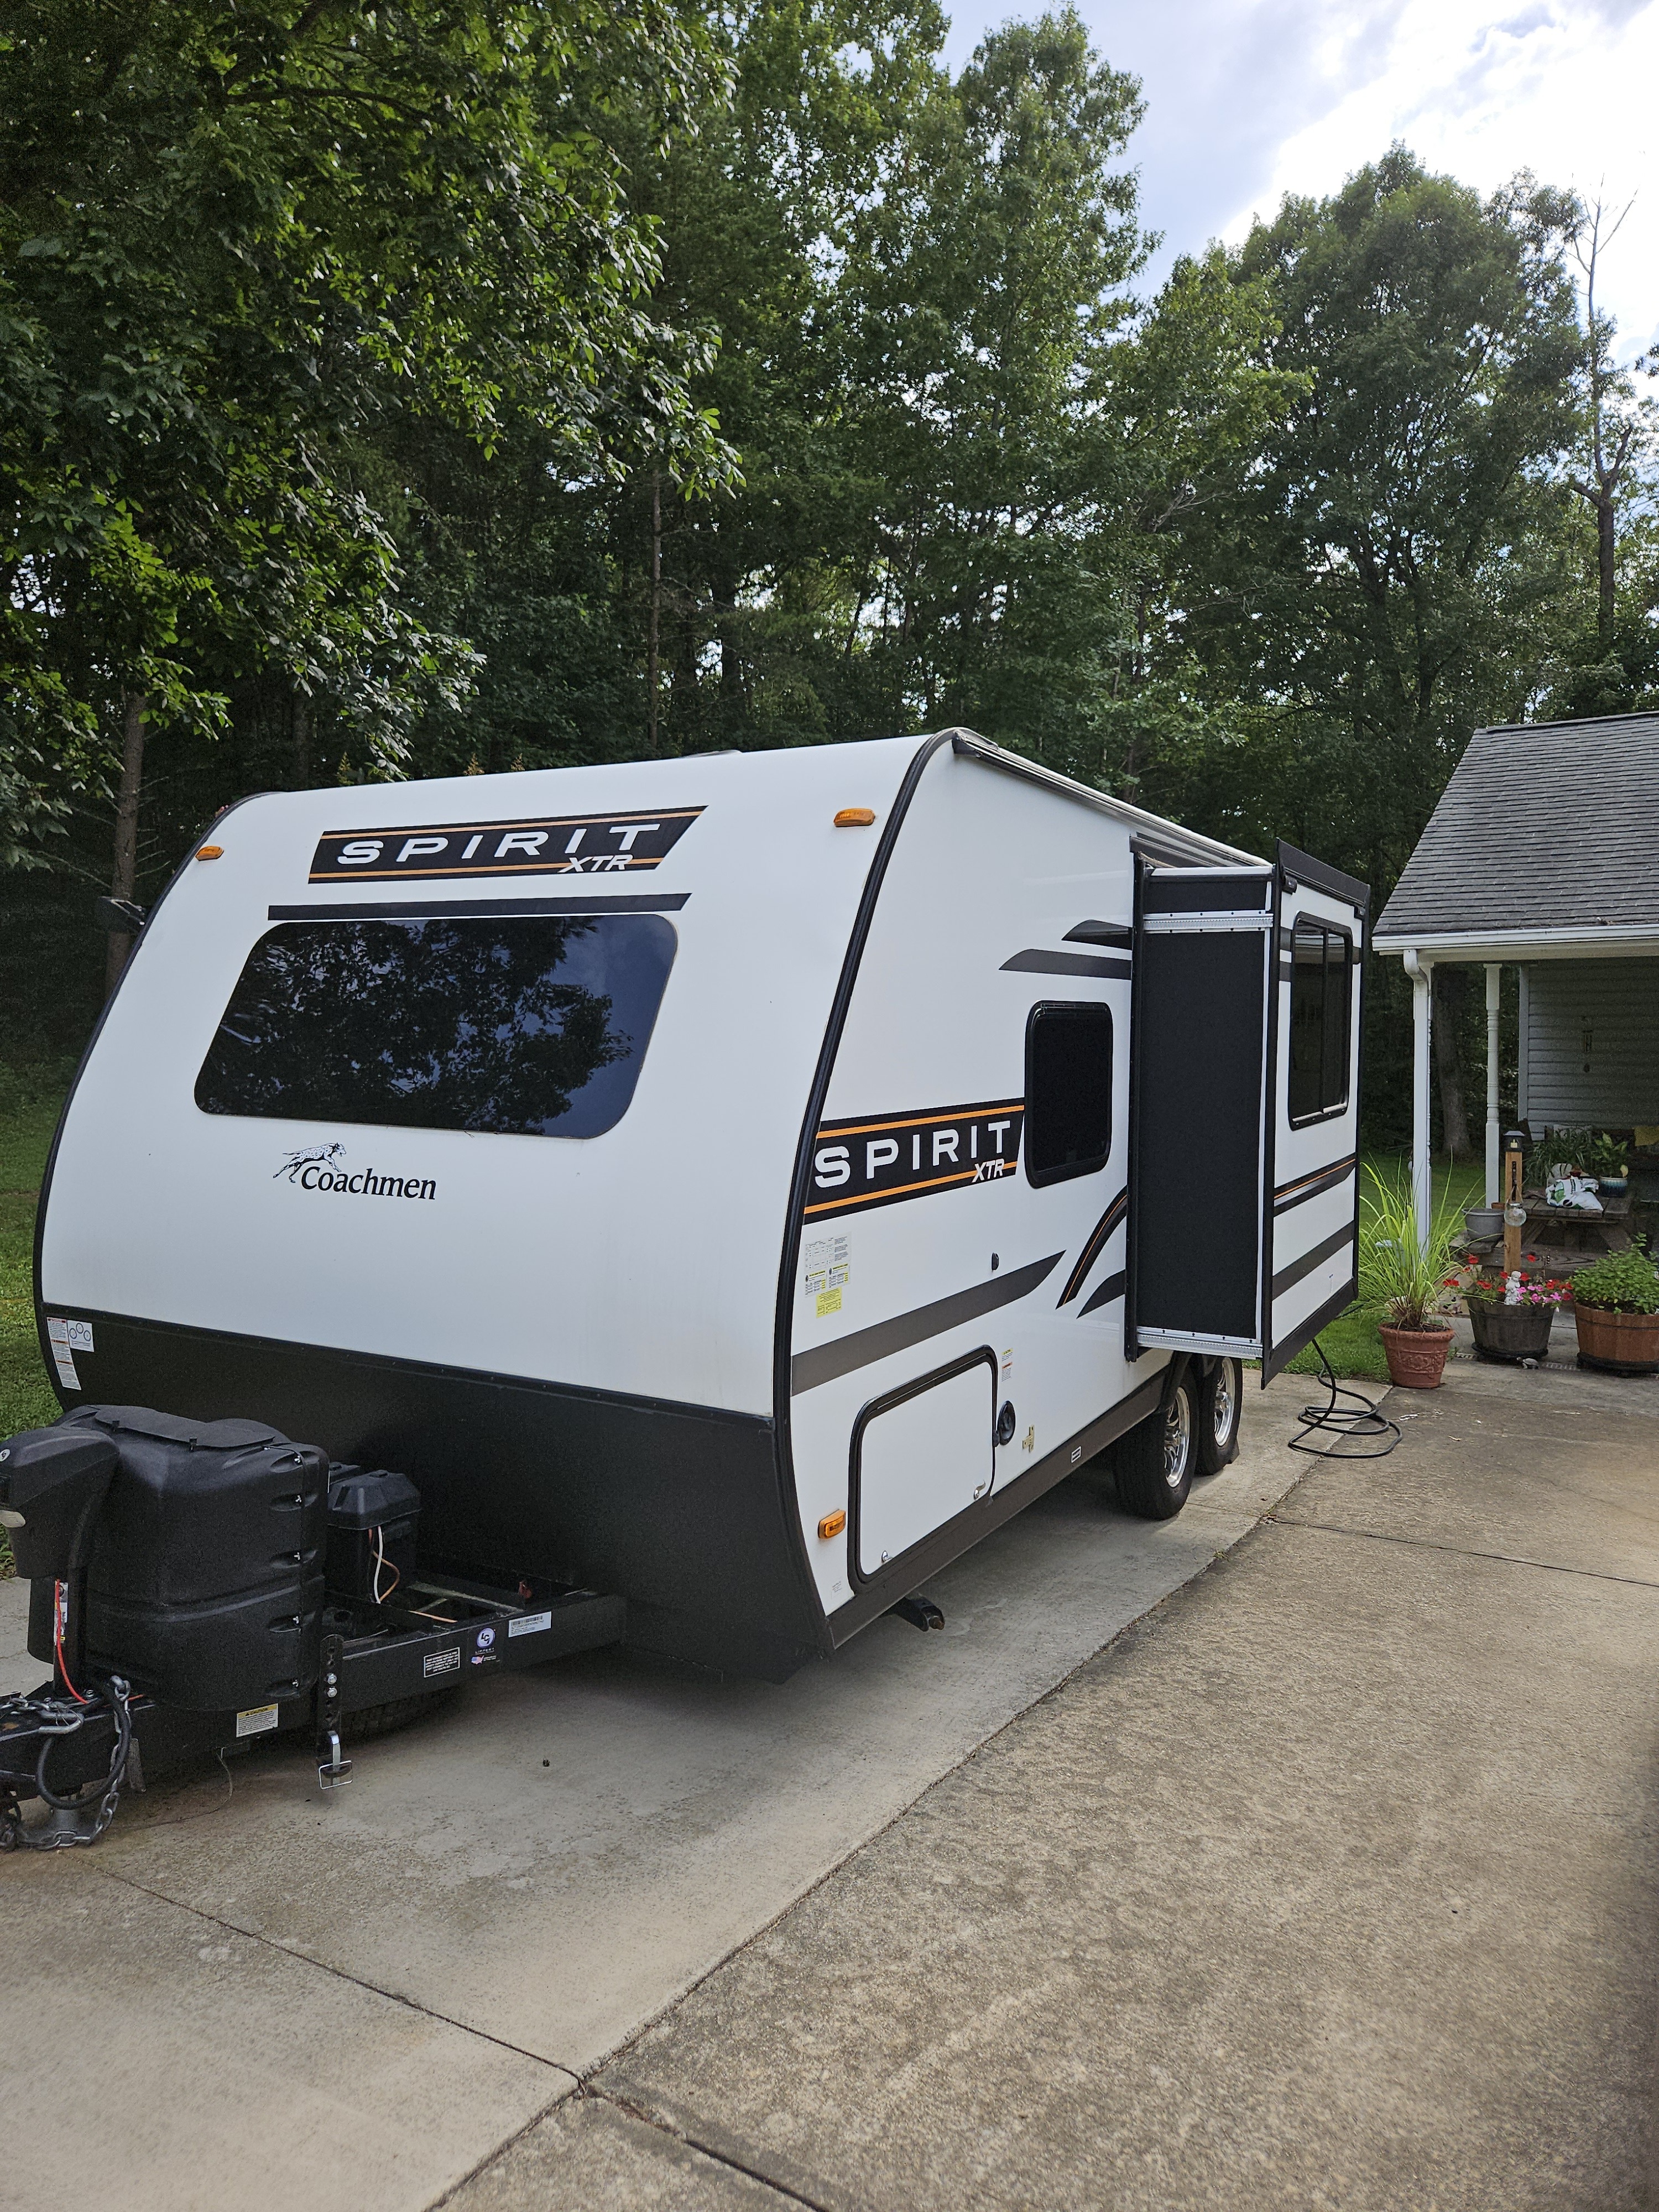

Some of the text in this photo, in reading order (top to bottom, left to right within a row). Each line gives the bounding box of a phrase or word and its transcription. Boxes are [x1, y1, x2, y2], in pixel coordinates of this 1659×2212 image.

[337, 823, 660, 864] SPIRIT
[557, 854, 633, 873] XTR
[815, 1120, 1011, 1188] SPIRIT
[972, 1159, 1004, 1183] XTR
[301, 1166, 437, 1200] Coachmen
